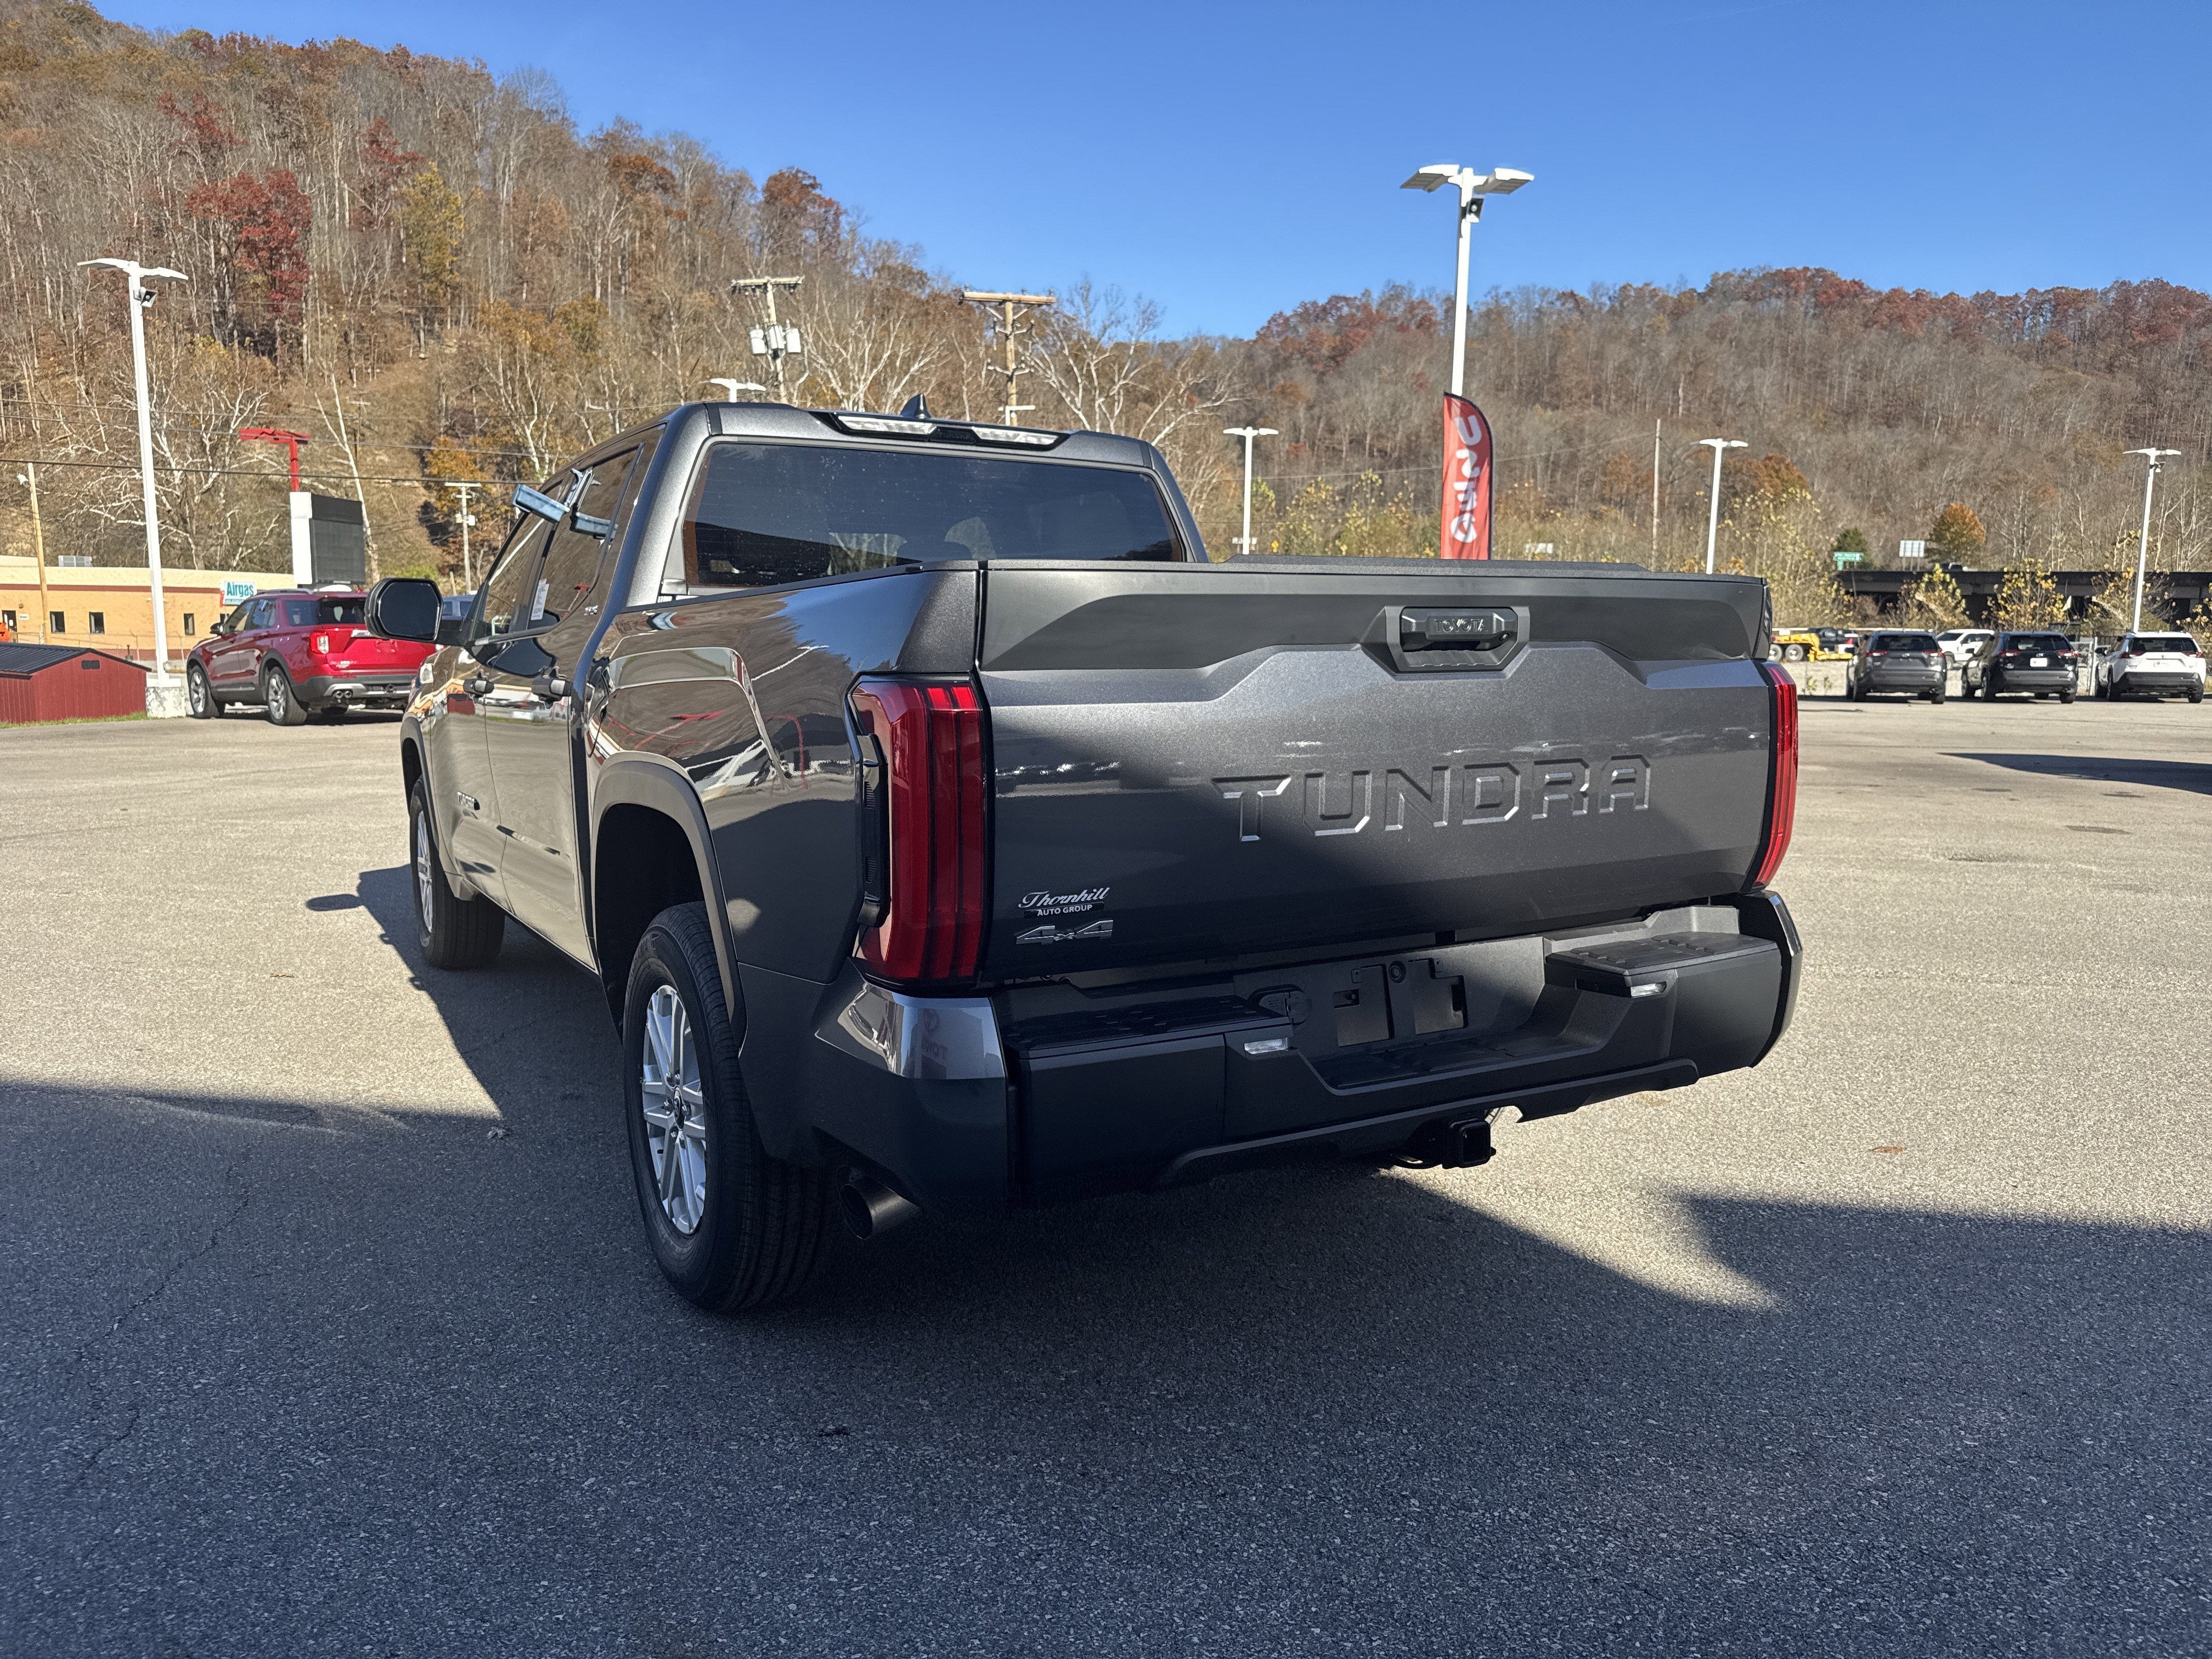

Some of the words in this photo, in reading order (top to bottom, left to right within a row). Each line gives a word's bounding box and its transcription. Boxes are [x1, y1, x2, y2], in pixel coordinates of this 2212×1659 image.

[227, 582, 254, 597] Airgas
[1434, 618, 1489, 632] TOYOTA
[1211, 754, 1651, 842] TUNDRA
[1018, 887, 1110, 908] Thornhill
[1063, 904, 1093, 913] GROUP
